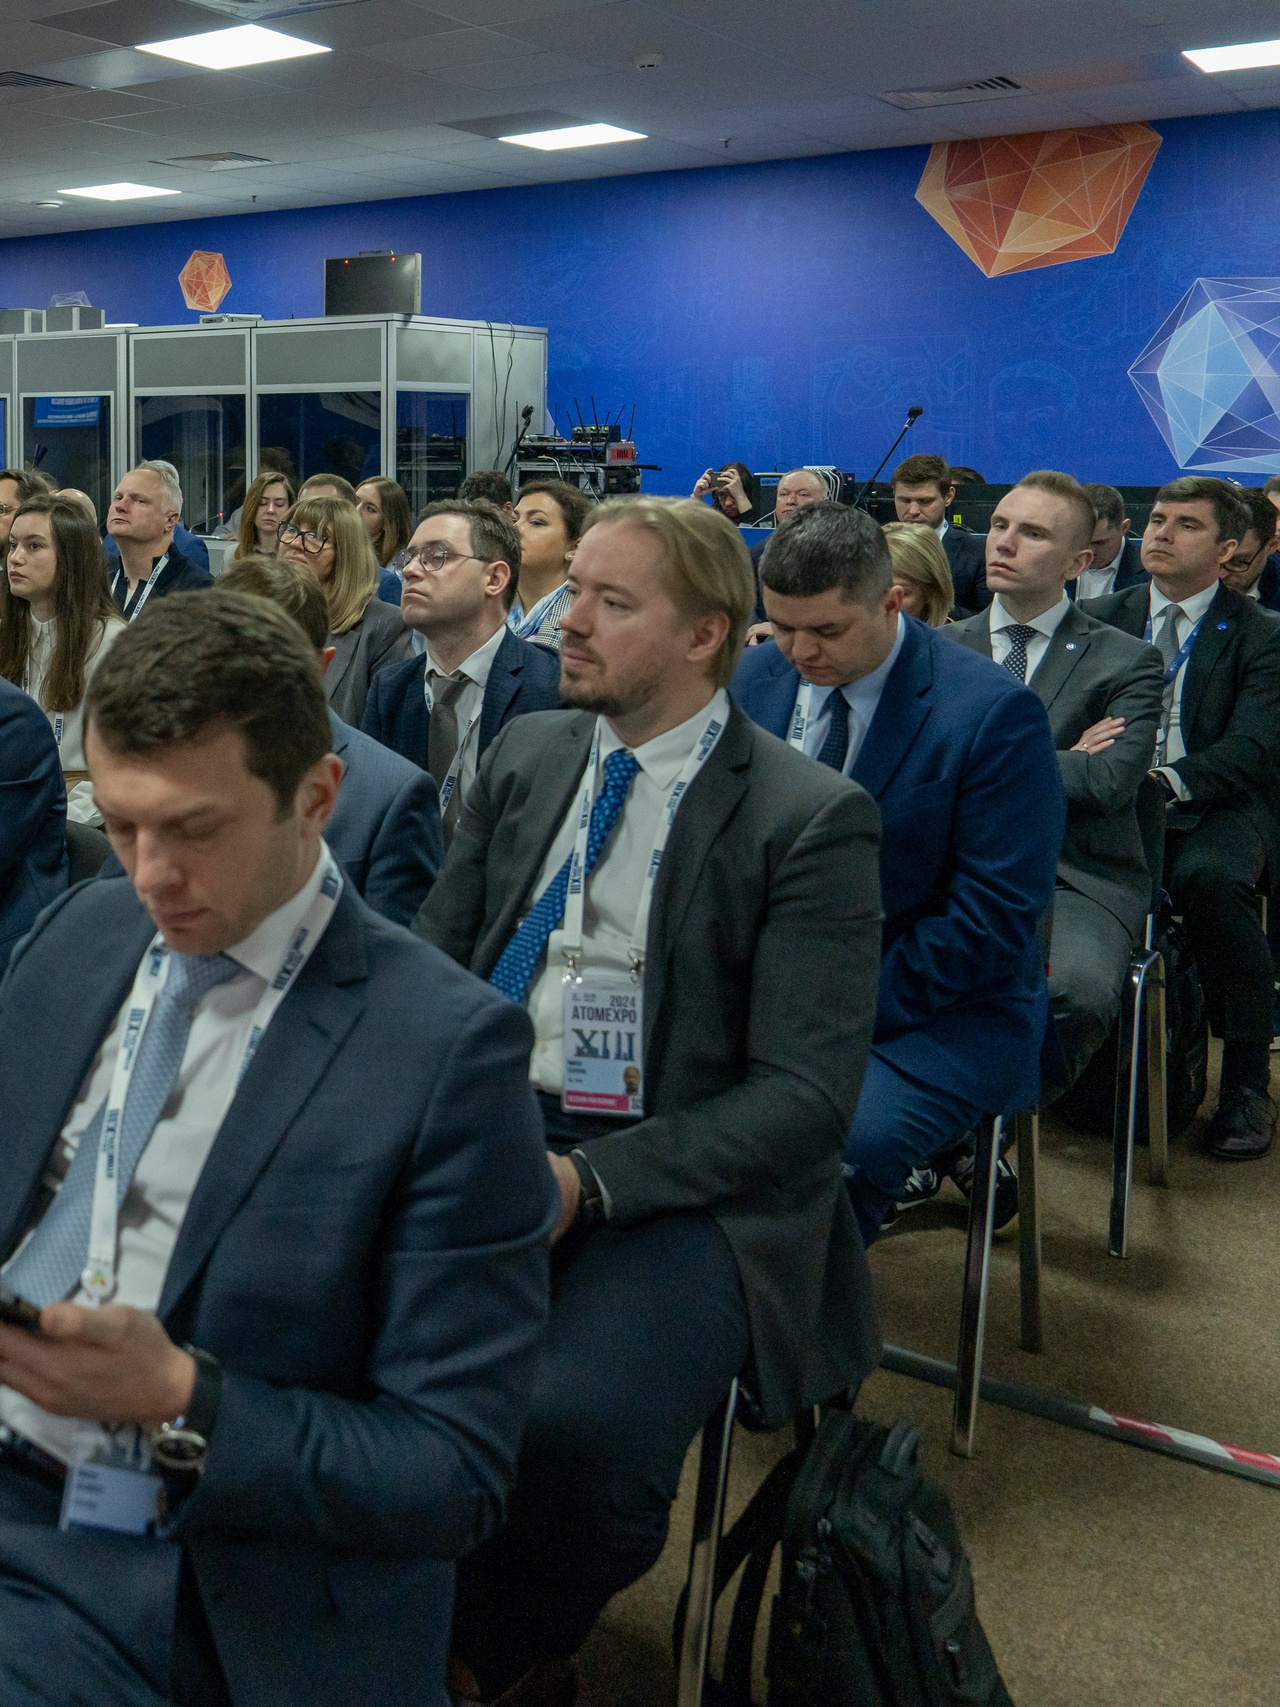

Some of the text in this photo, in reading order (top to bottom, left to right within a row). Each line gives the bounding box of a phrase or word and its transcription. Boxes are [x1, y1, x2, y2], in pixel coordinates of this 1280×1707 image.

[792, 725, 804, 740] XIII
[445, 775, 457, 789] XIII
[609, 994, 637, 1008] 2024
[571, 1005, 637, 1024] ATOMEXPO
